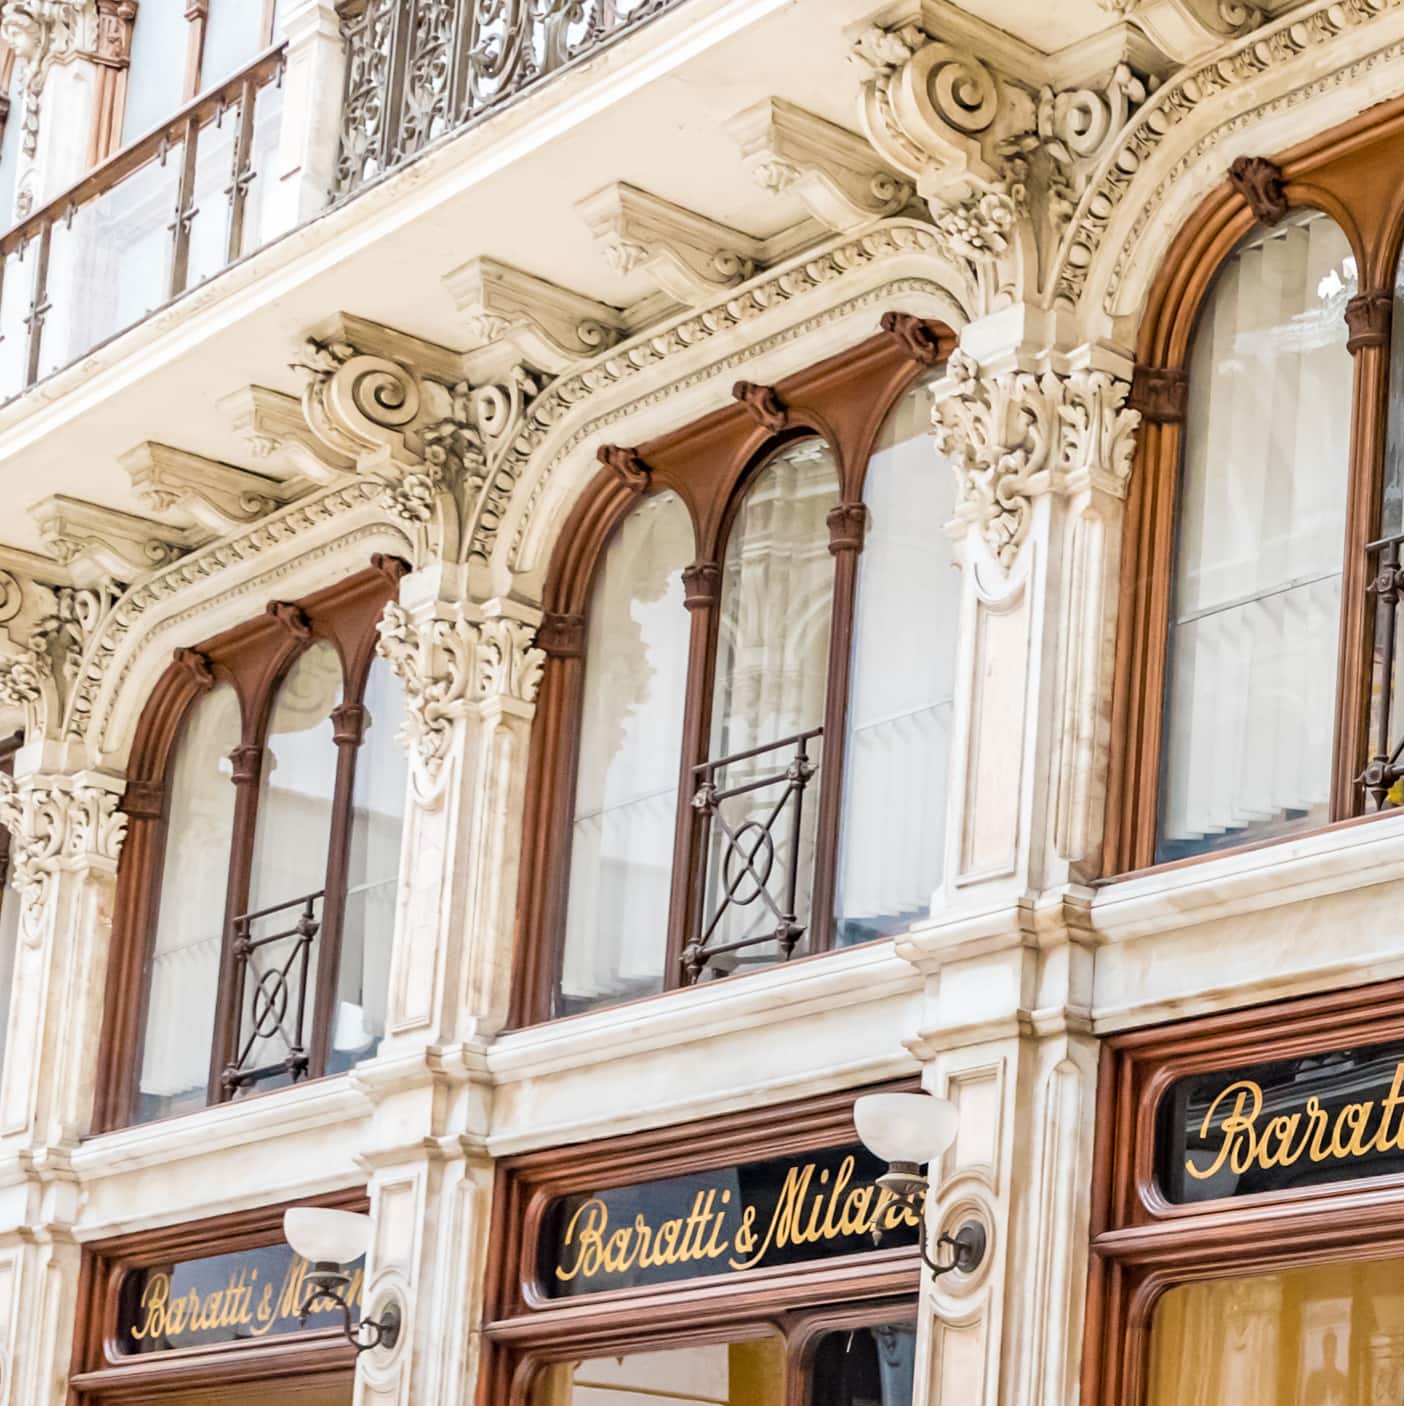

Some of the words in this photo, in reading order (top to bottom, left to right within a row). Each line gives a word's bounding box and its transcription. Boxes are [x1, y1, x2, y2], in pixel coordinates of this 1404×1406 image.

[555, 1189, 731, 1280] Baratti
[734, 1204, 757, 1253] &
[131, 1263, 257, 1340] Baratti
[256, 1281, 273, 1322] &
